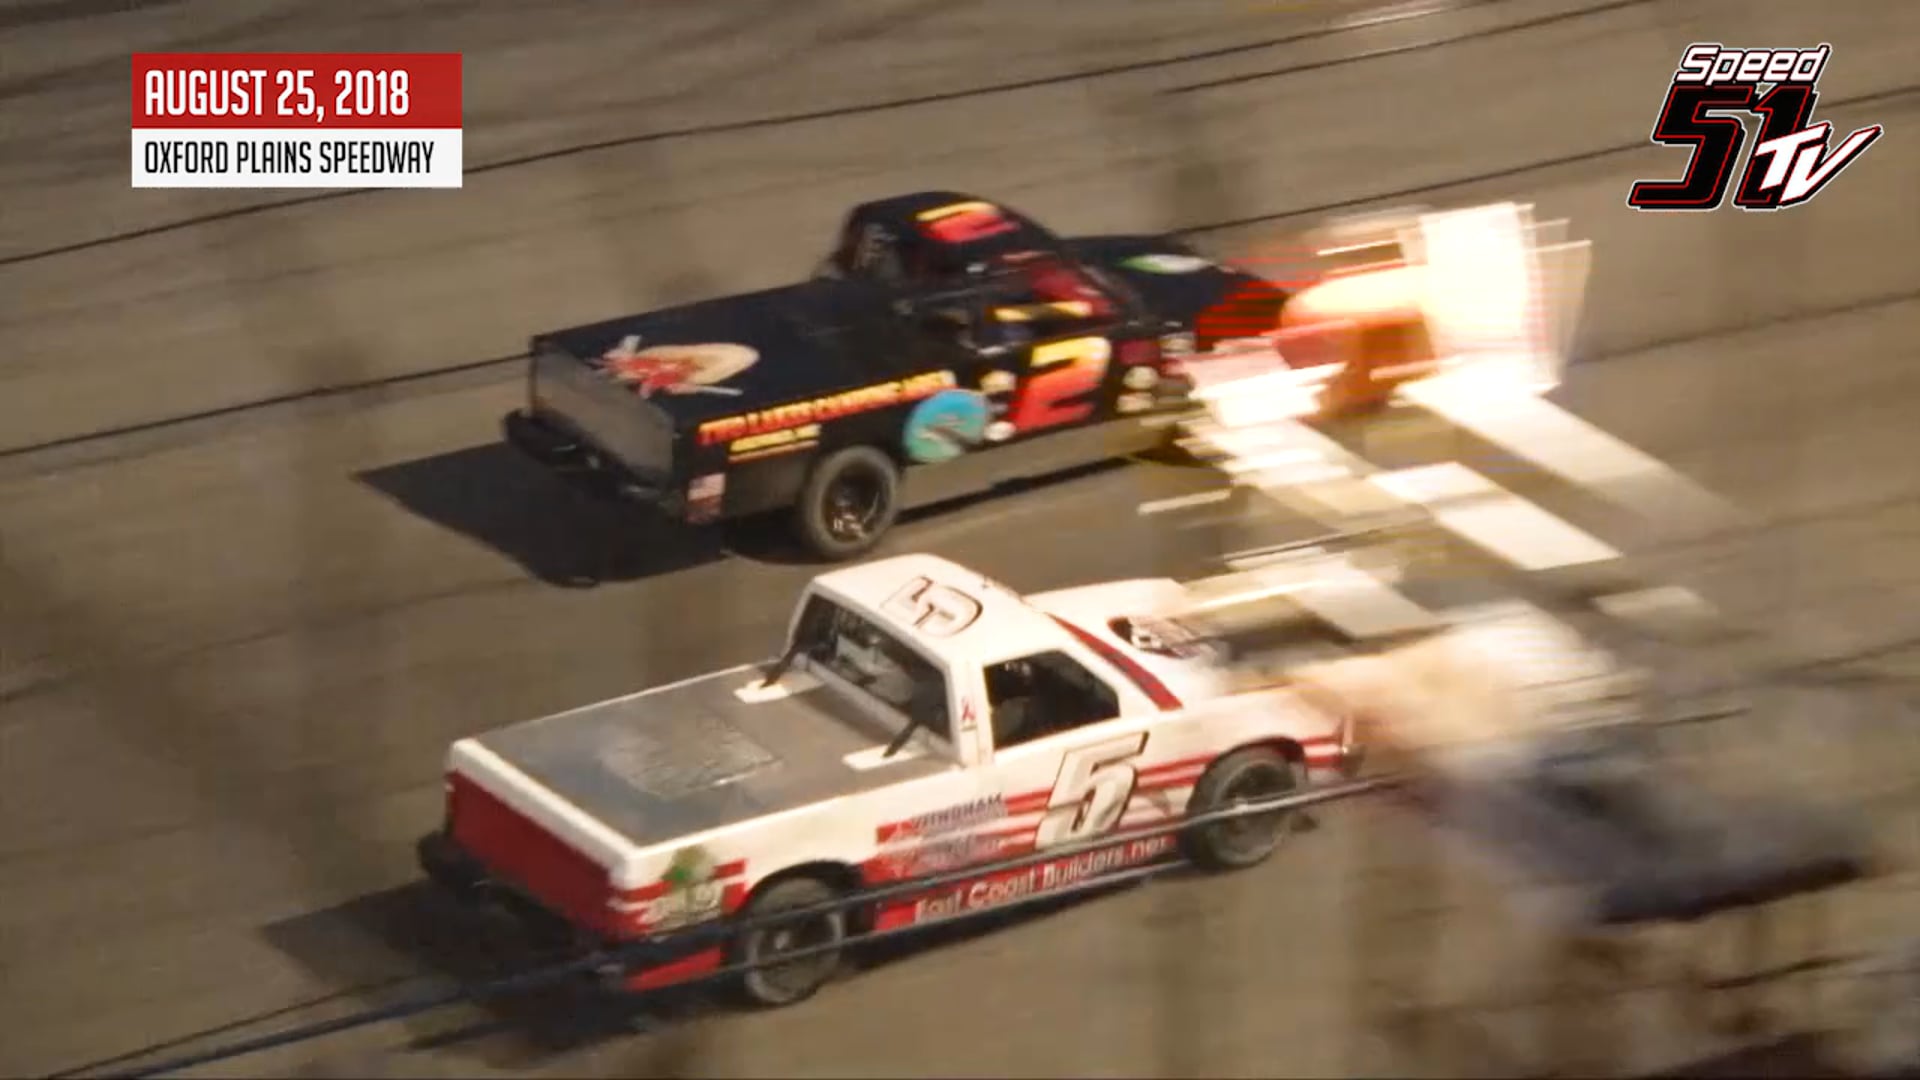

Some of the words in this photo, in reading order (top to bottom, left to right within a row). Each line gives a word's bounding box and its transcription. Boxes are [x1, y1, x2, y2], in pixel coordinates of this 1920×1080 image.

[912, 200, 1021, 243] 2
[1010, 336, 1112, 431] 2
[880, 576, 984, 638] 5
[1034, 731, 1150, 851] 5
